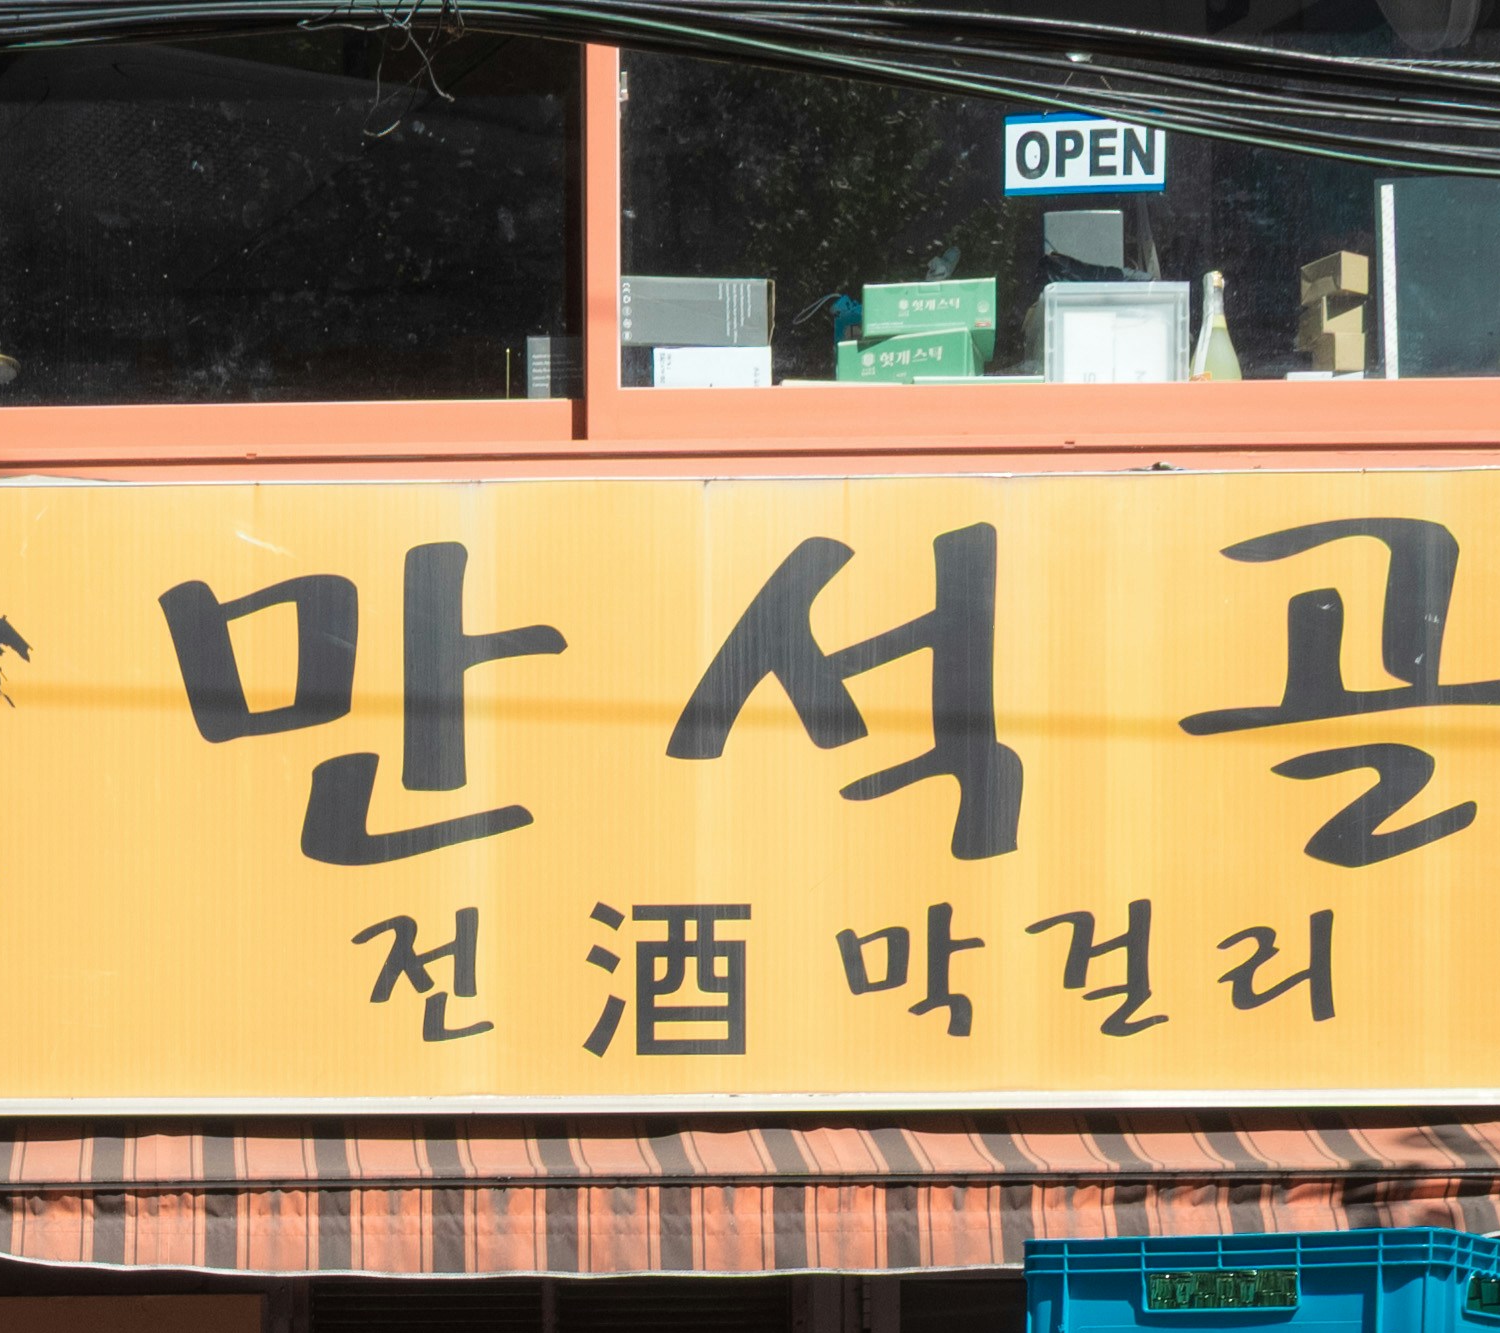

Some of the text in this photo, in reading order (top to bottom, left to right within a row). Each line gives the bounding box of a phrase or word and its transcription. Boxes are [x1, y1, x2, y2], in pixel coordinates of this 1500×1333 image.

[1015, 124, 1156, 183] OPEN
[352, 897, 1335, 1057] 전 酒 막걸리
